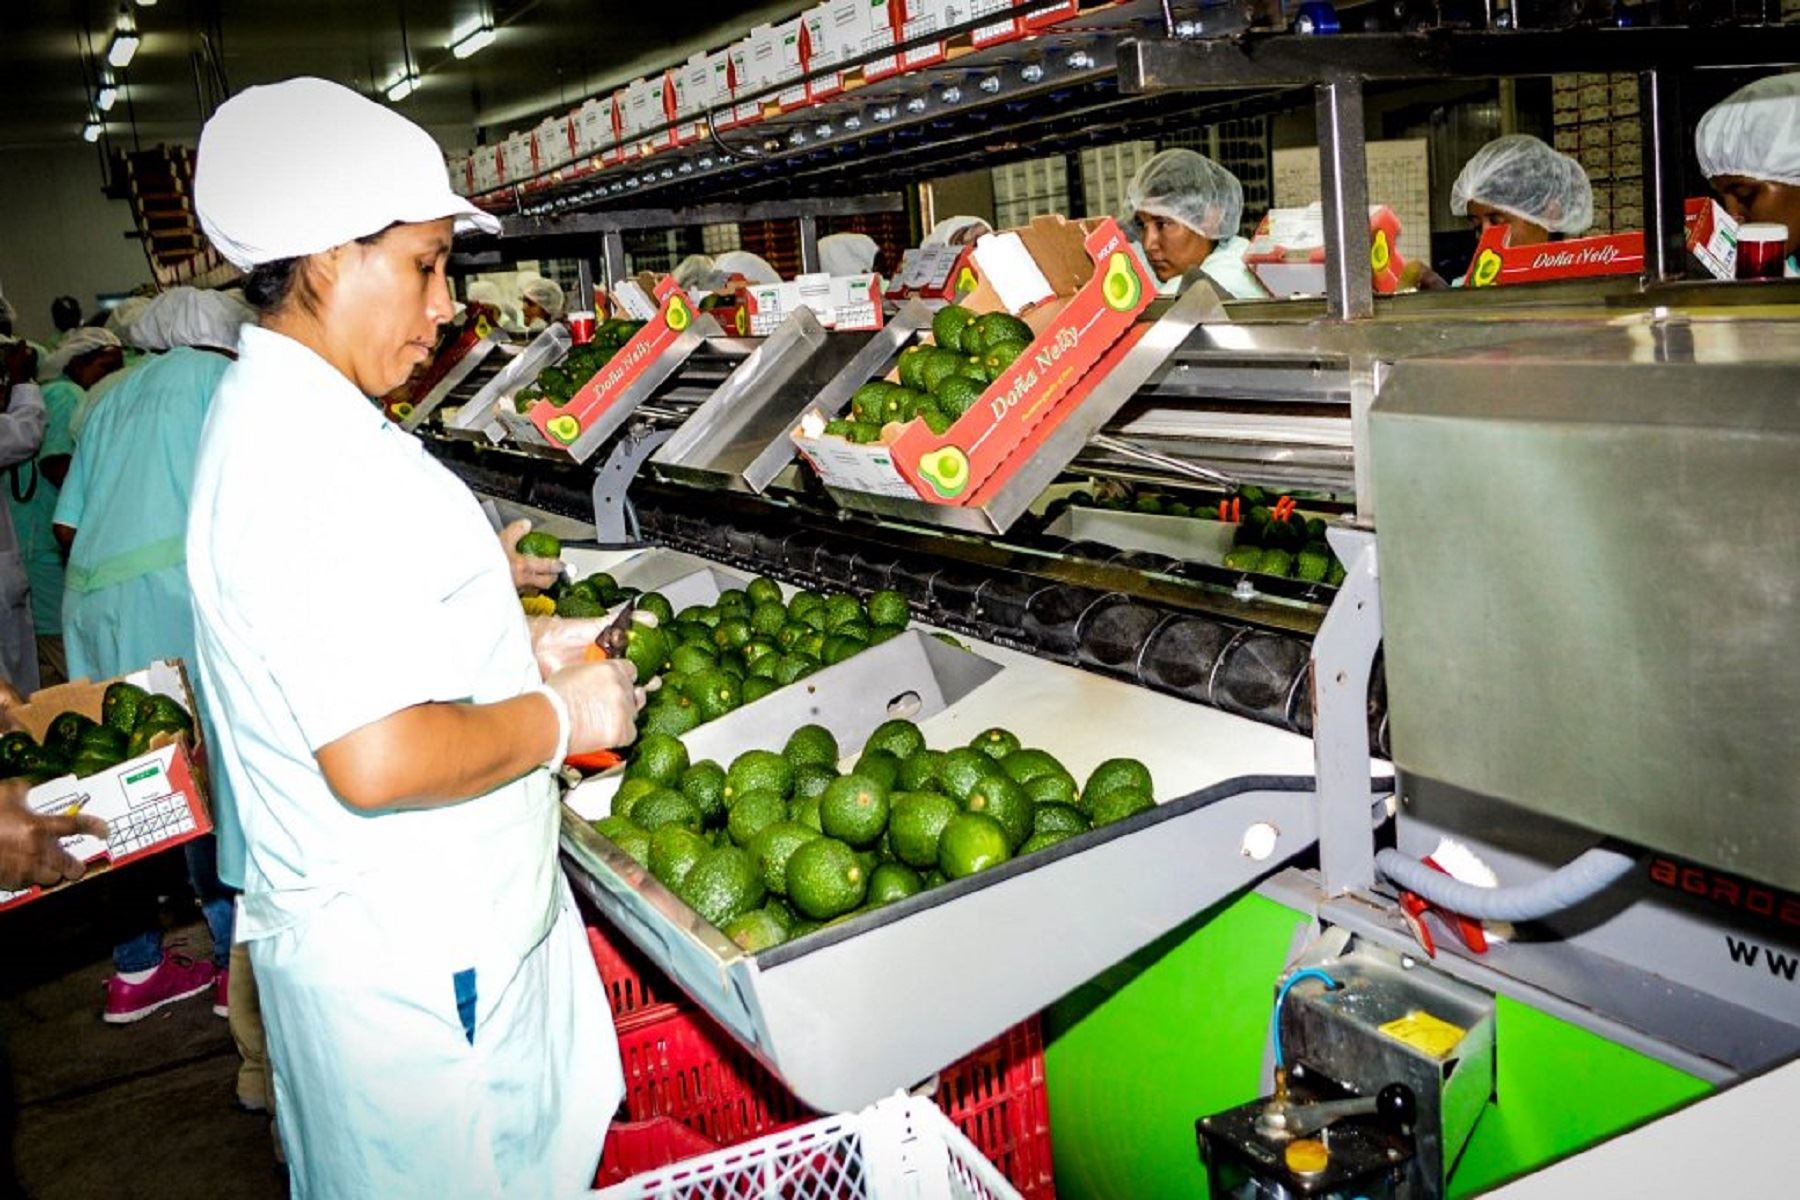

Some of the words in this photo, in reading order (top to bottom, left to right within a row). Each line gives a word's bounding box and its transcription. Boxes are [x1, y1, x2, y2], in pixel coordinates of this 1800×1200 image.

[1533, 251, 1574, 268] Doña
[1576, 245, 1619, 265] Nelly
[991, 368, 1037, 421] Doña
[1035, 326, 1078, 374] Nelly
